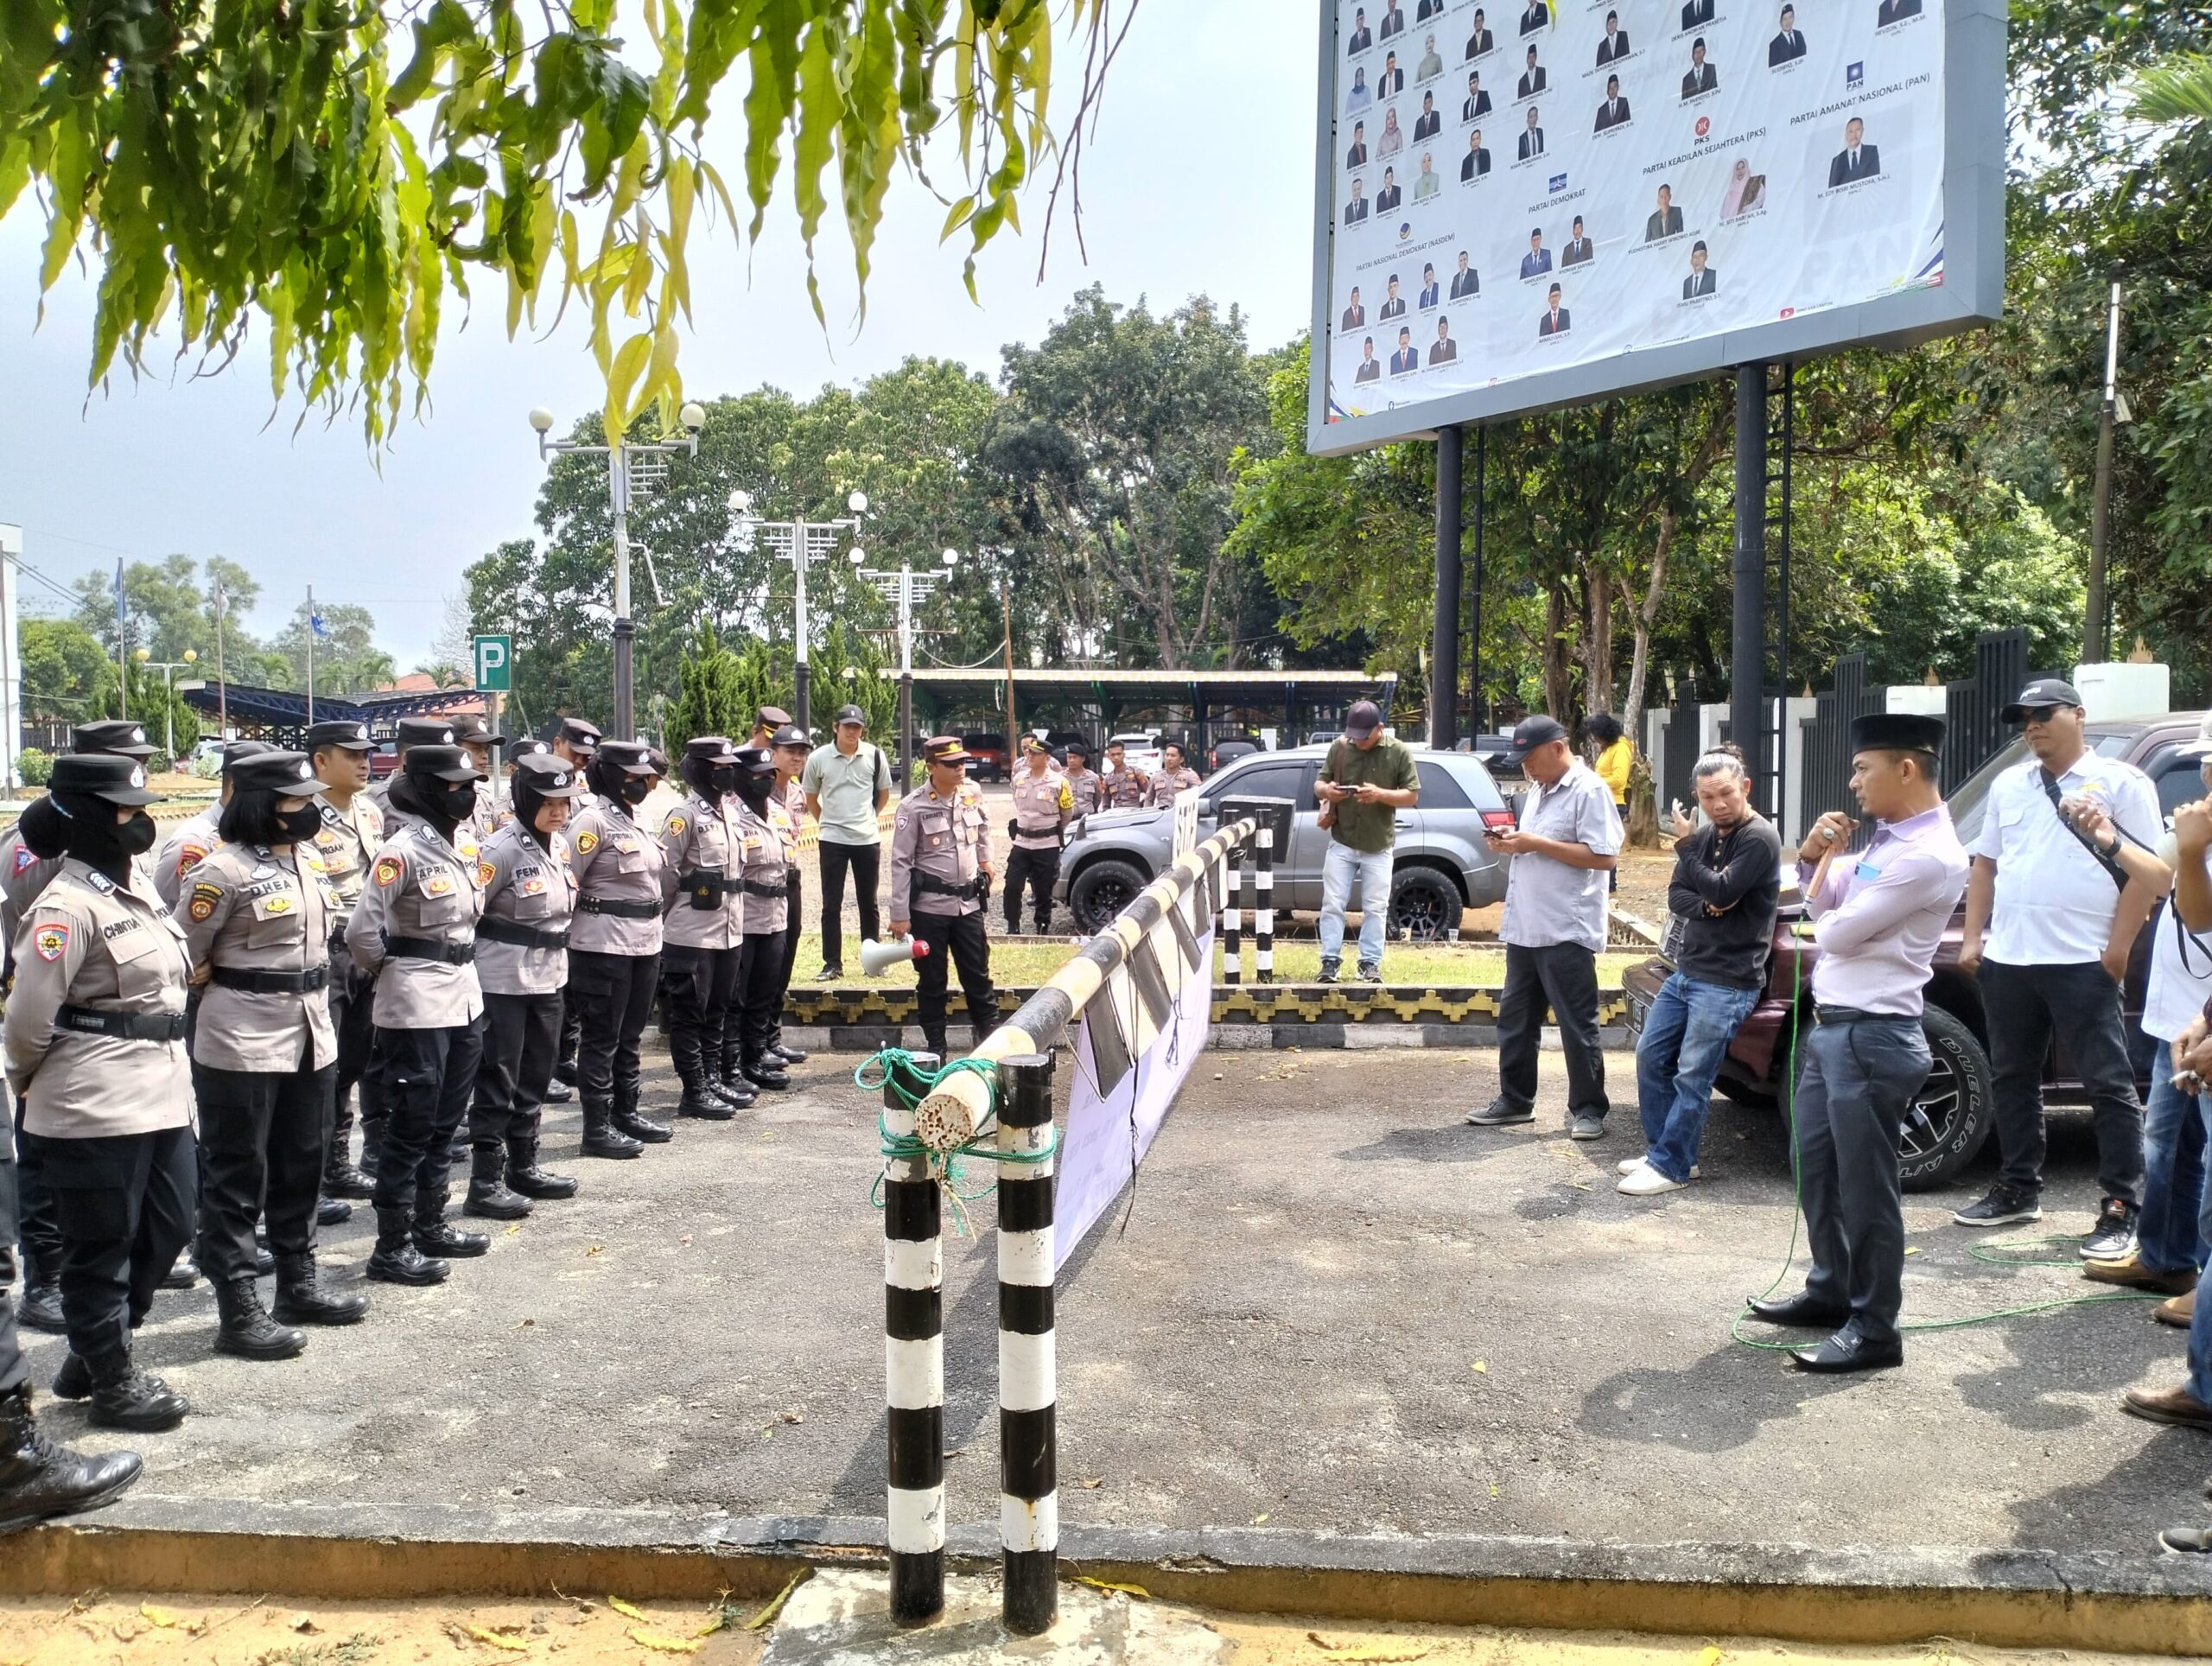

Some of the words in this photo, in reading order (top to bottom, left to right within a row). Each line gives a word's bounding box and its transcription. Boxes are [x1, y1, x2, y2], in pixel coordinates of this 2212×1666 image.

[1846, 79, 1864, 91] PAN
[1790, 110, 1818, 125] PARTAI
[1819, 97, 1857, 117] AMANAT
[1859, 81, 1904, 104] NASIONAL
[1905, 72, 1930, 90] (PAN)
[1643, 161, 1667, 175] PARTAI
[1668, 149, 1703, 167] KEADILAN
[1705, 135, 1745, 155] SEJAHTERA
[1746, 126, 1766, 142] (PKS)
[1694, 135, 1711, 146] PKS
[1528, 200, 1549, 214] PARTAI
[1550, 188, 1586, 207] DEMOKRAT
[1356, 261, 1372, 272] PARTAI
[1373, 252, 1398, 266] NASIONAL
[1399, 243, 1427, 258] DEMOKRAT
[1428, 232, 1455, 249] (NASDEM)
[480, 642, 505, 684] P
[418, 868, 448, 879] APRIL
[515, 867, 540, 878] FENI
[250, 880, 292, 896] DHEA
[1939, 1037, 1981, 1154] DUELER
[1897, 1154, 1944, 1178] A/T
